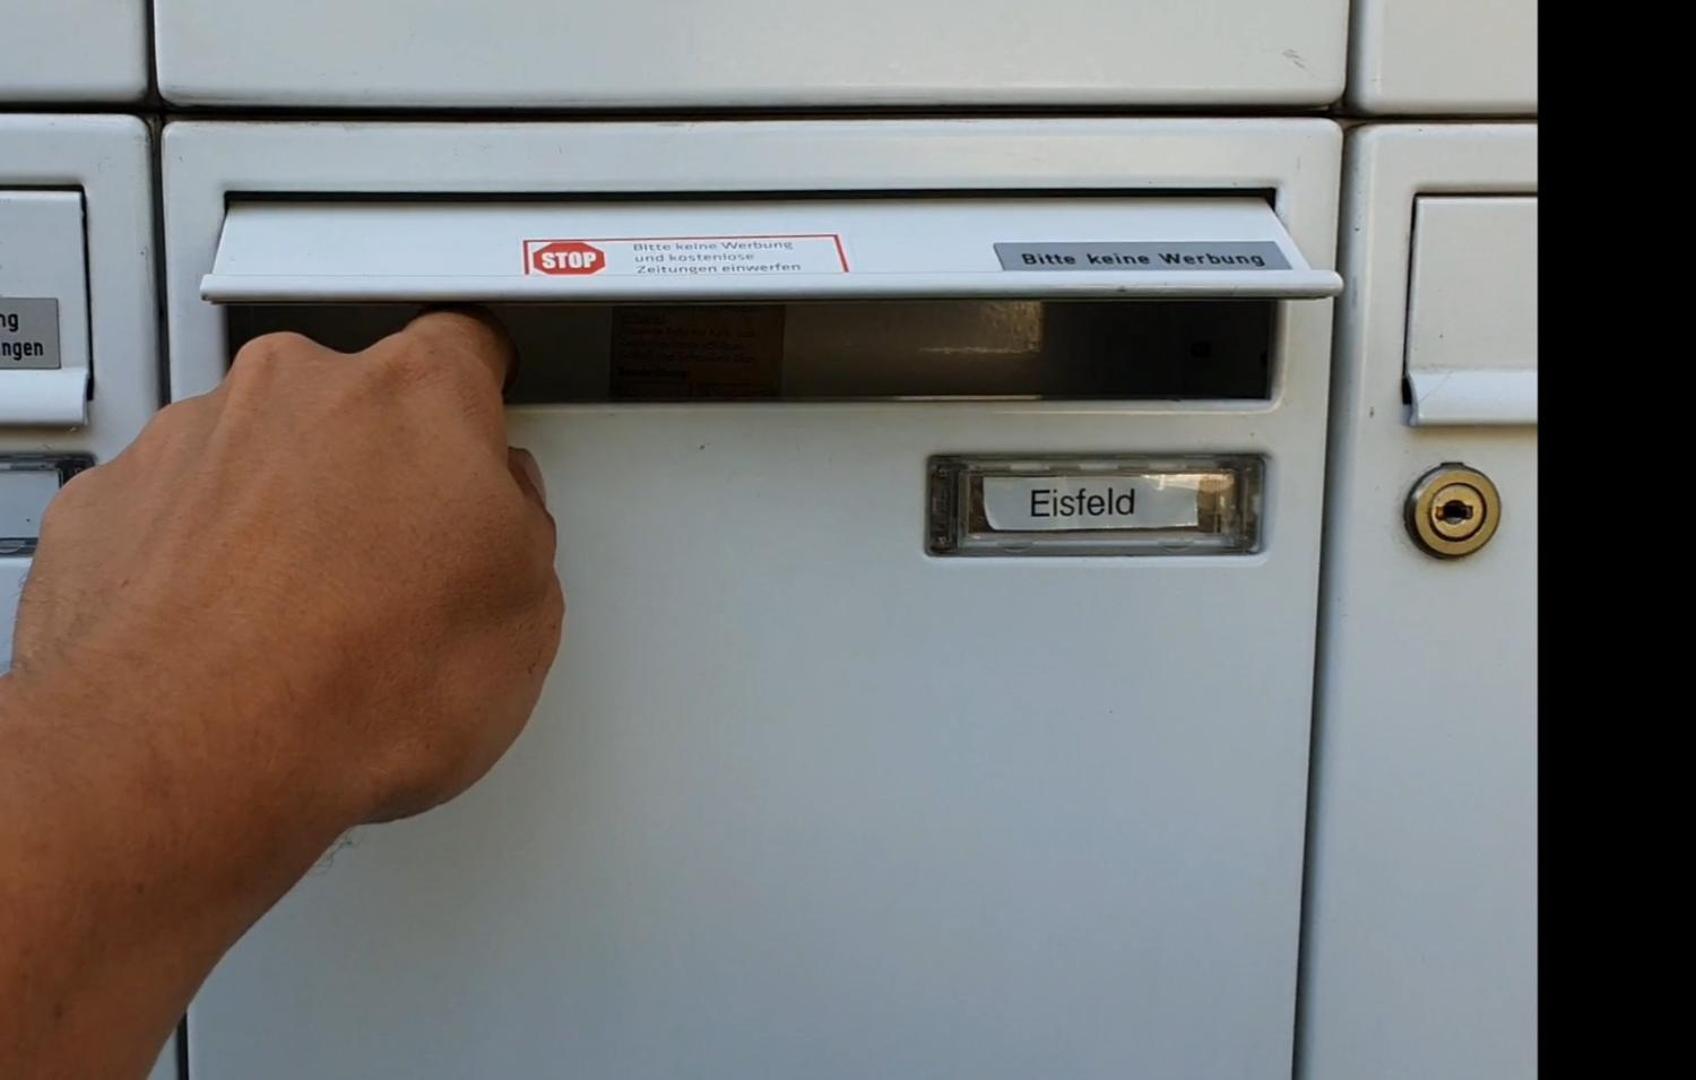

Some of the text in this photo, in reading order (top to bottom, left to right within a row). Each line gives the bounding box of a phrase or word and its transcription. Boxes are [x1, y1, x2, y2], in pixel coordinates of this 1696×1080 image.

[633, 241, 793, 251] Bitte keine Werbung
[541, 251, 597, 269] STOP
[635, 253, 754, 262] und kostenlose
[1021, 252, 1266, 267] Bitte keine Werbung
[636, 262, 801, 274] Zeitungen einwerfen
[1030, 487, 1136, 517] Eisfeld
